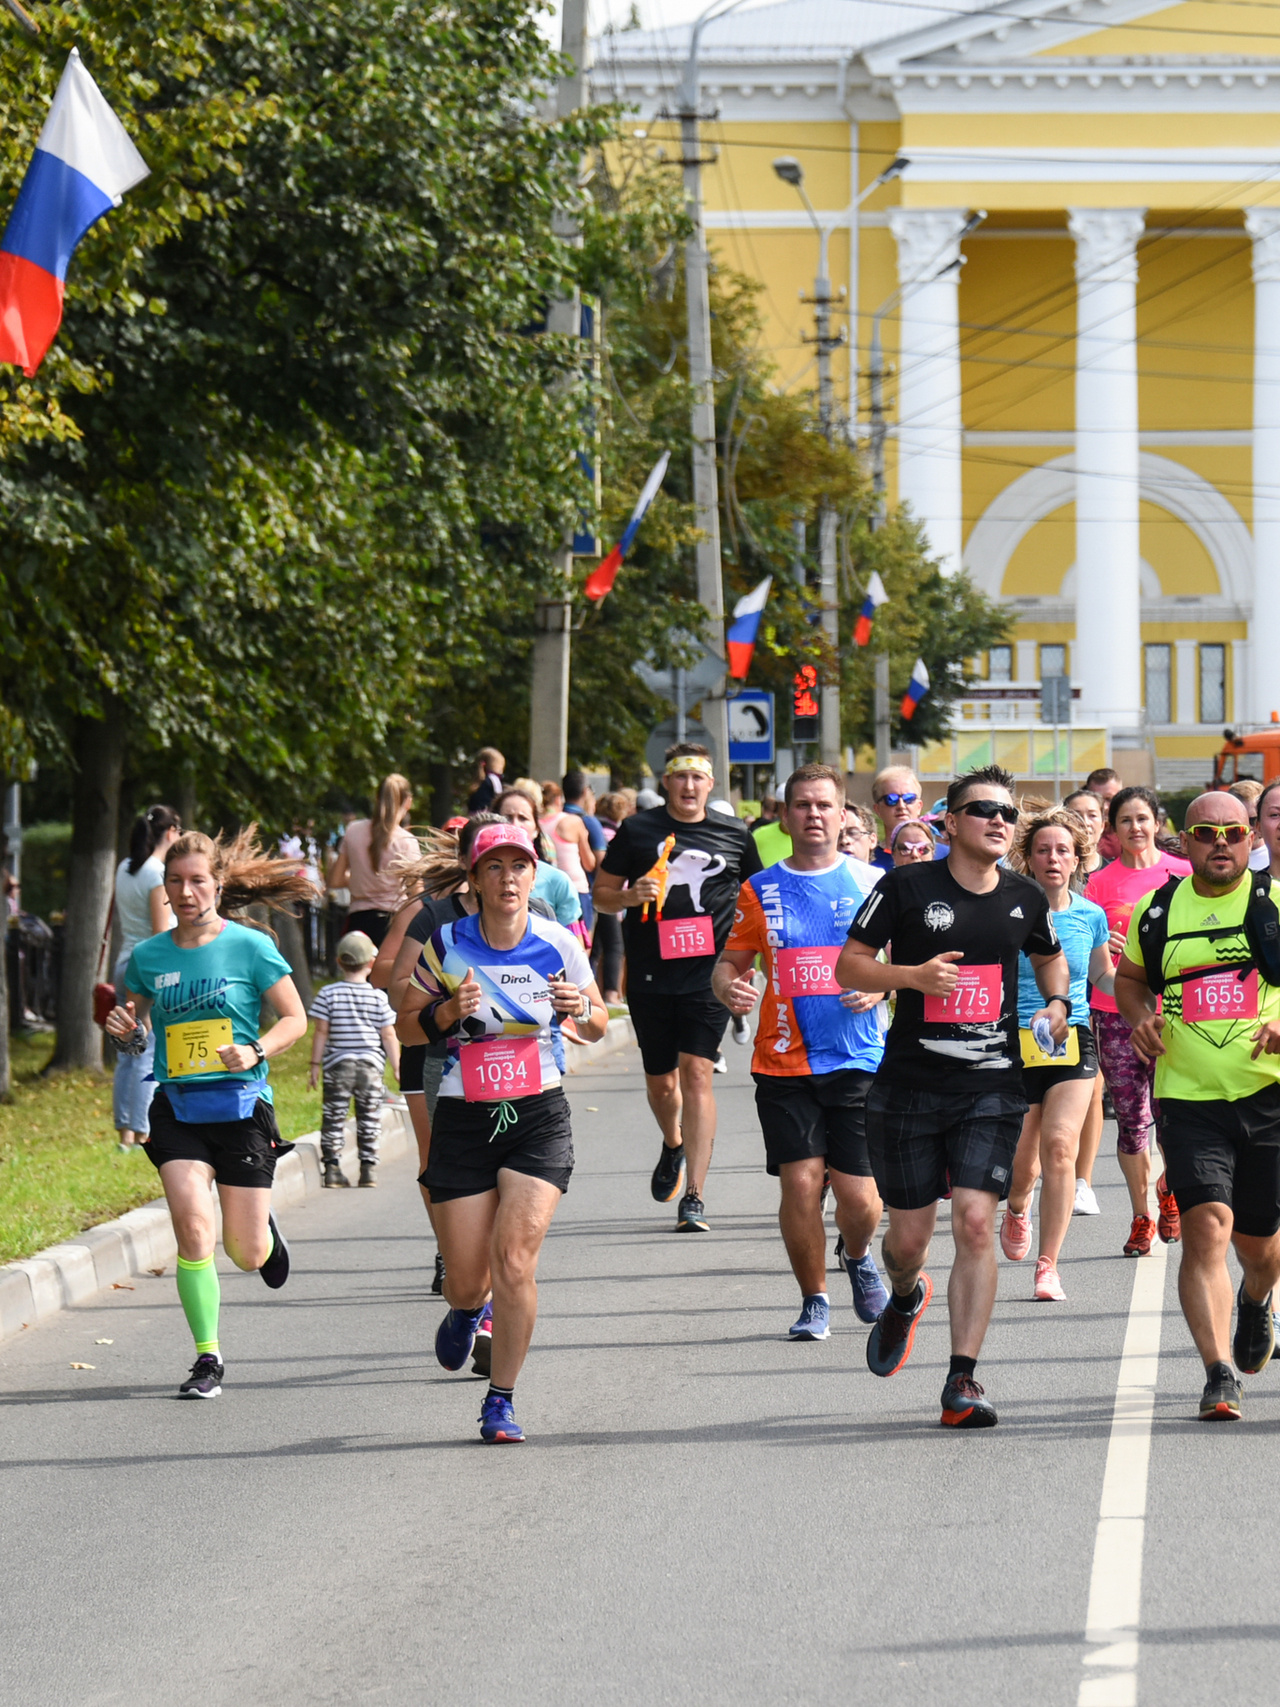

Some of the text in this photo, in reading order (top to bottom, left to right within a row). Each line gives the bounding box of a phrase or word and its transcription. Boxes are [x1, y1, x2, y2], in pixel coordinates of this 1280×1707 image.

[669, 931, 706, 948] 1115
[788, 965, 833, 984] 1309
[1194, 984, 1245, 1006] 1655
[773, 1002, 792, 1054] RUN
[186, 1041, 208, 1059] 75
[476, 1060, 527, 1084] 1034
